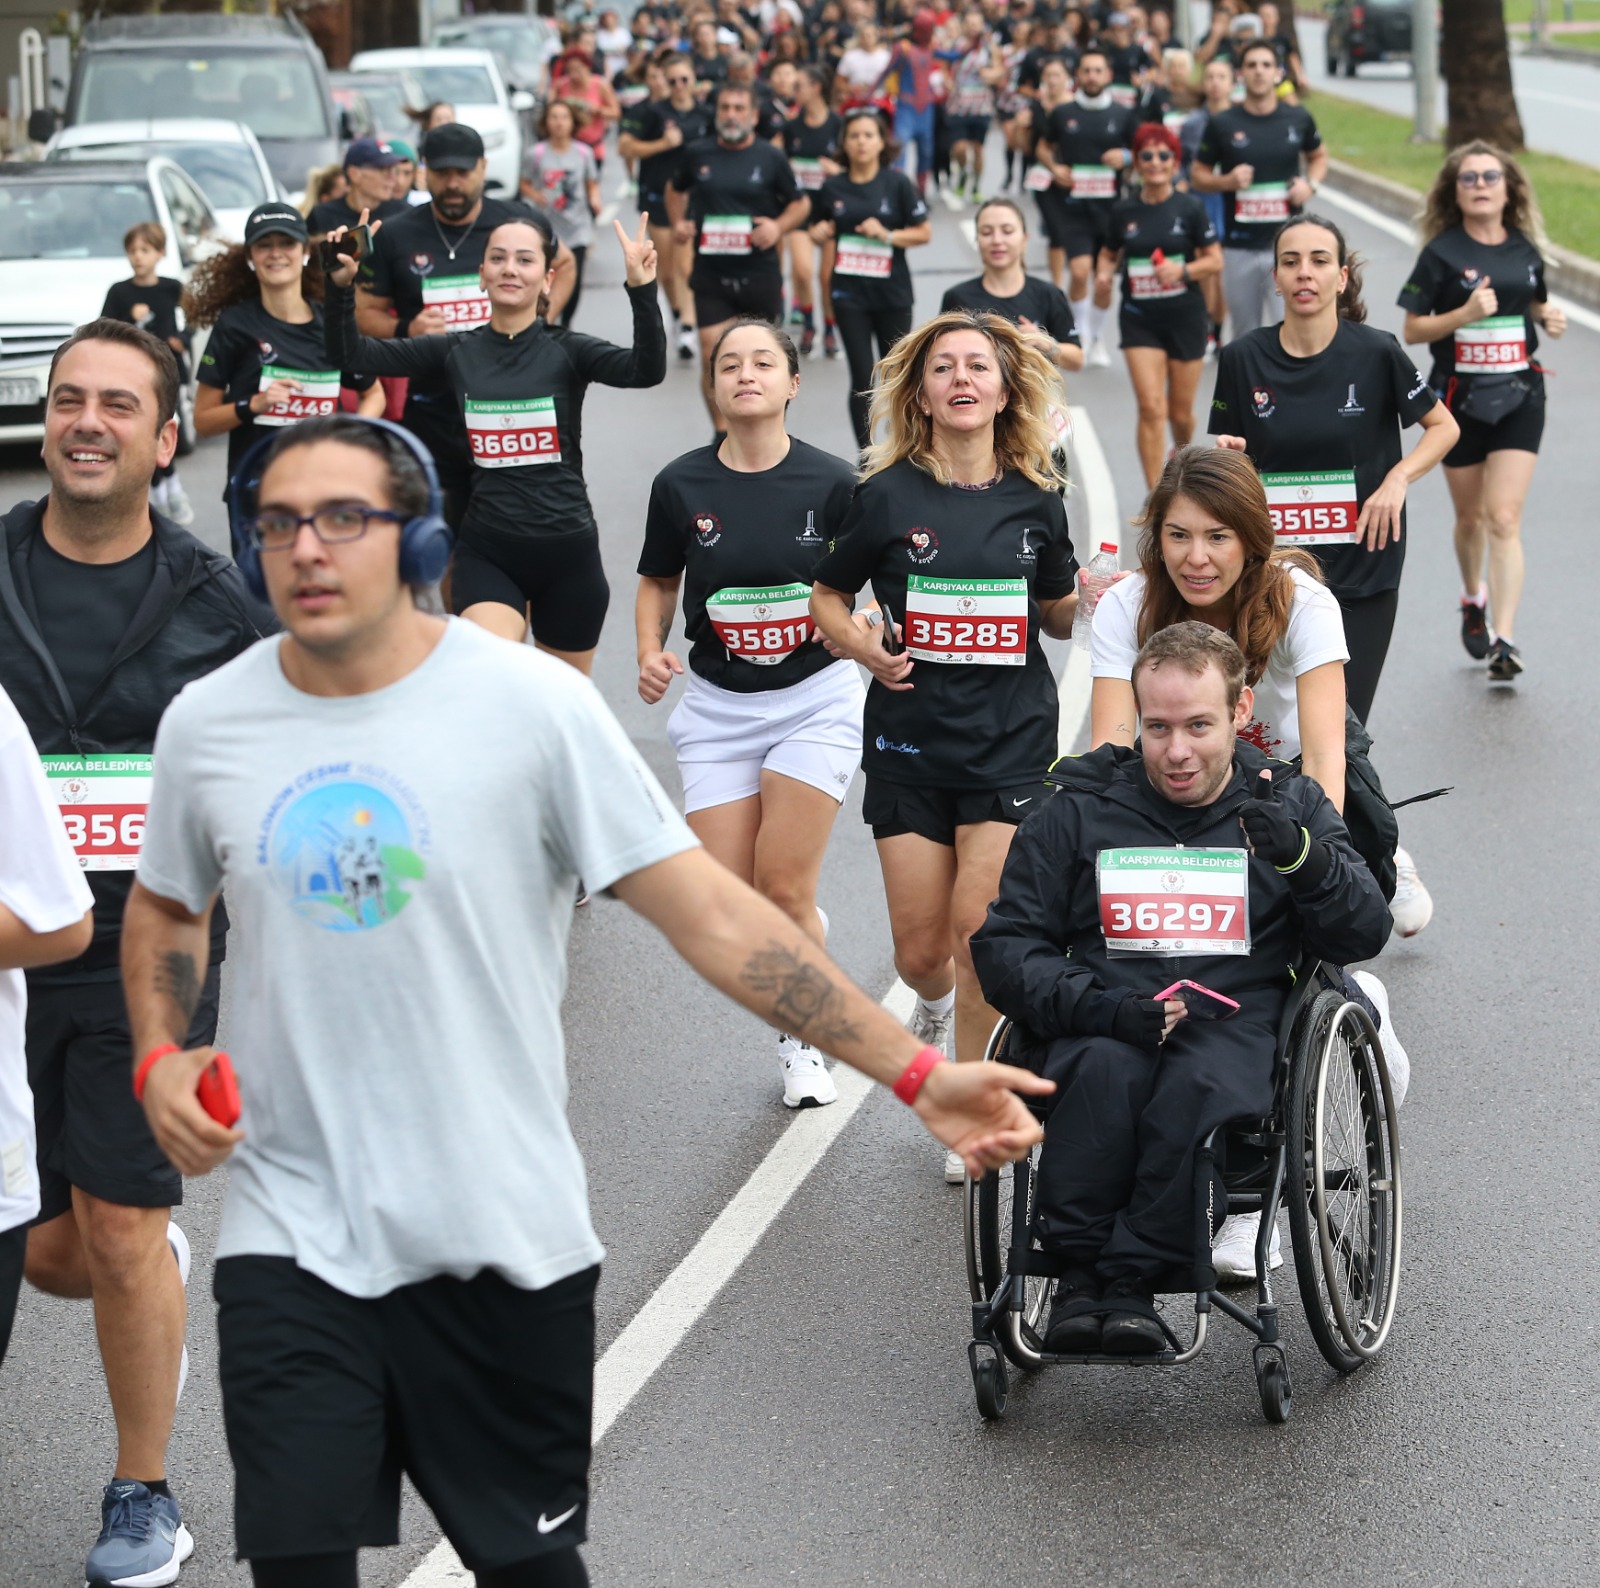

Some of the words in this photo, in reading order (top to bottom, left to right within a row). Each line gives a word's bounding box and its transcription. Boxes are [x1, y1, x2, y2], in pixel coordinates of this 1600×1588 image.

[1460, 343, 1521, 363] 35581
[268, 399, 334, 416] 5449
[471, 431, 554, 455] 36602
[1267, 475, 1309, 484] KARŞIYAKA
[1310, 474, 1355, 482] BELEDİYESİ
[1270, 507, 1347, 531] 35153
[719, 592, 767, 602] KARŞIYAKA
[923, 581, 975, 592] KARŞIYAKA
[976, 582, 1027, 592] BELEDİYESİ
[723, 622, 808, 650] 35811
[912, 619, 1020, 647] 35285
[63, 813, 146, 847] 356
[1119, 855, 1180, 866] KARŞIYAKA
[1182, 857, 1244, 868] BELEDİYESİ
[1110, 902, 1236, 932] 36297
